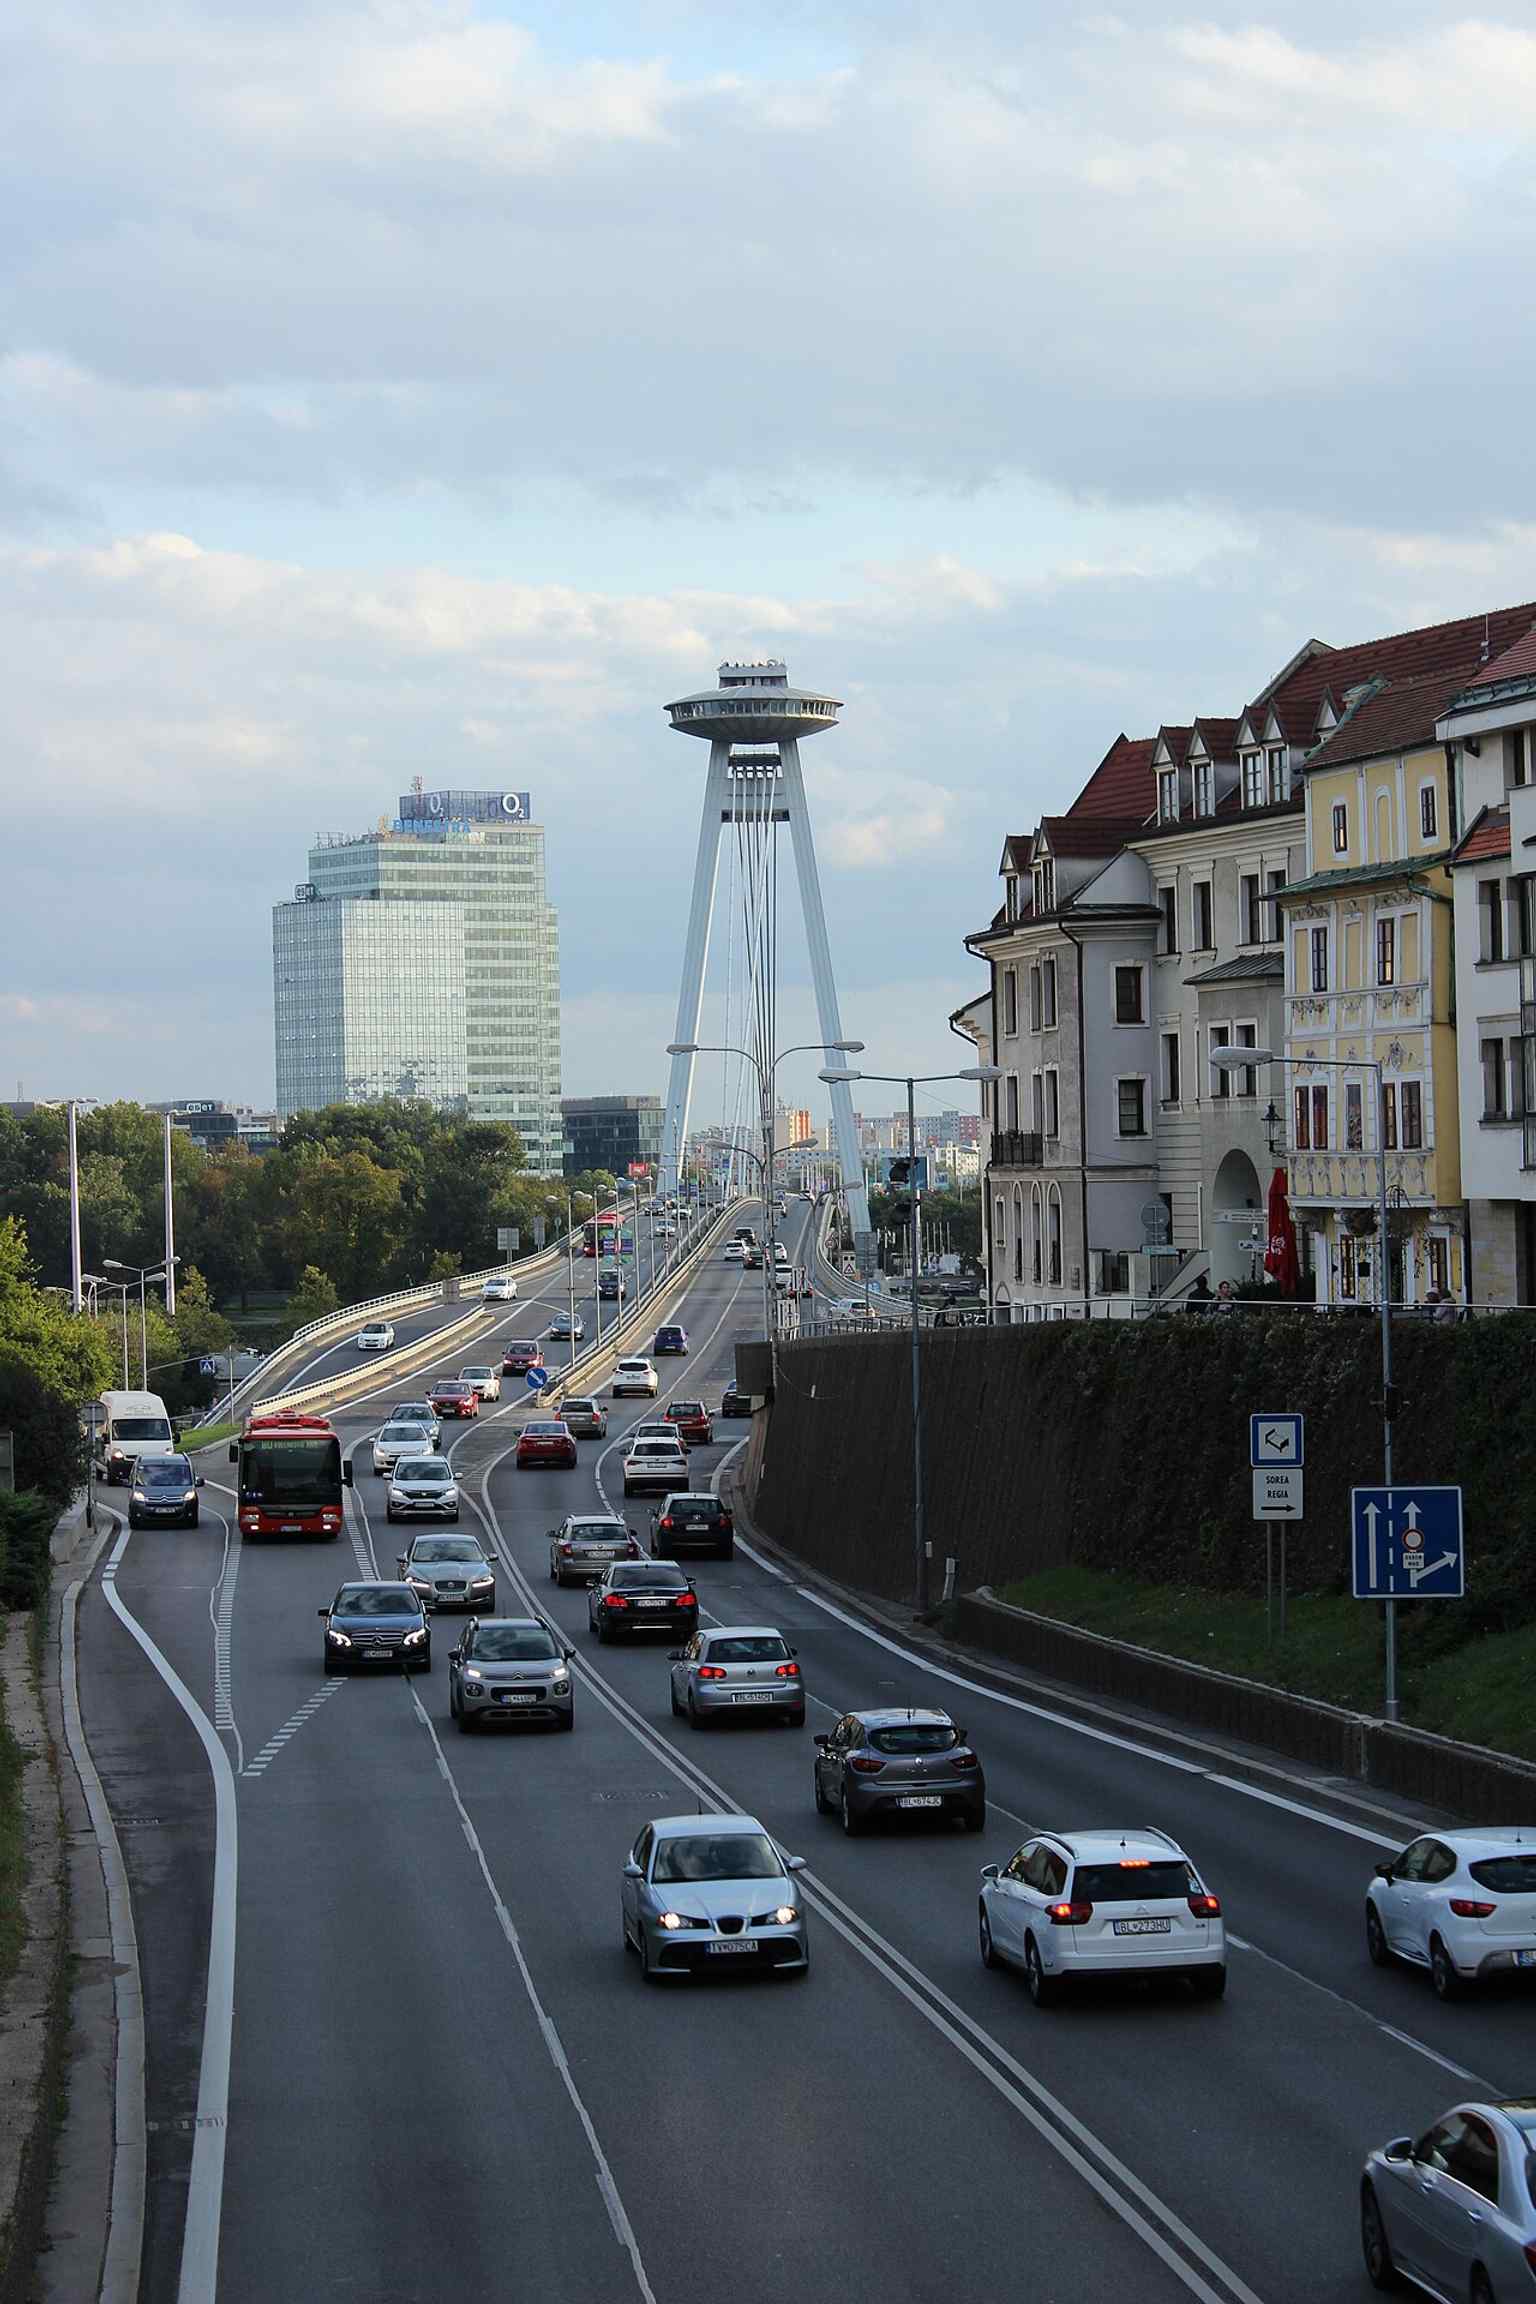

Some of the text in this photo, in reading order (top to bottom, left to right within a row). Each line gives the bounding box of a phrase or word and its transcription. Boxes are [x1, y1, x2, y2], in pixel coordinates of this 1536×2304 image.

[502, 793, 525, 818] O2
[1265, 1475, 1289, 1484] SOREA
[1267, 1490, 1289, 1498] REGIA
